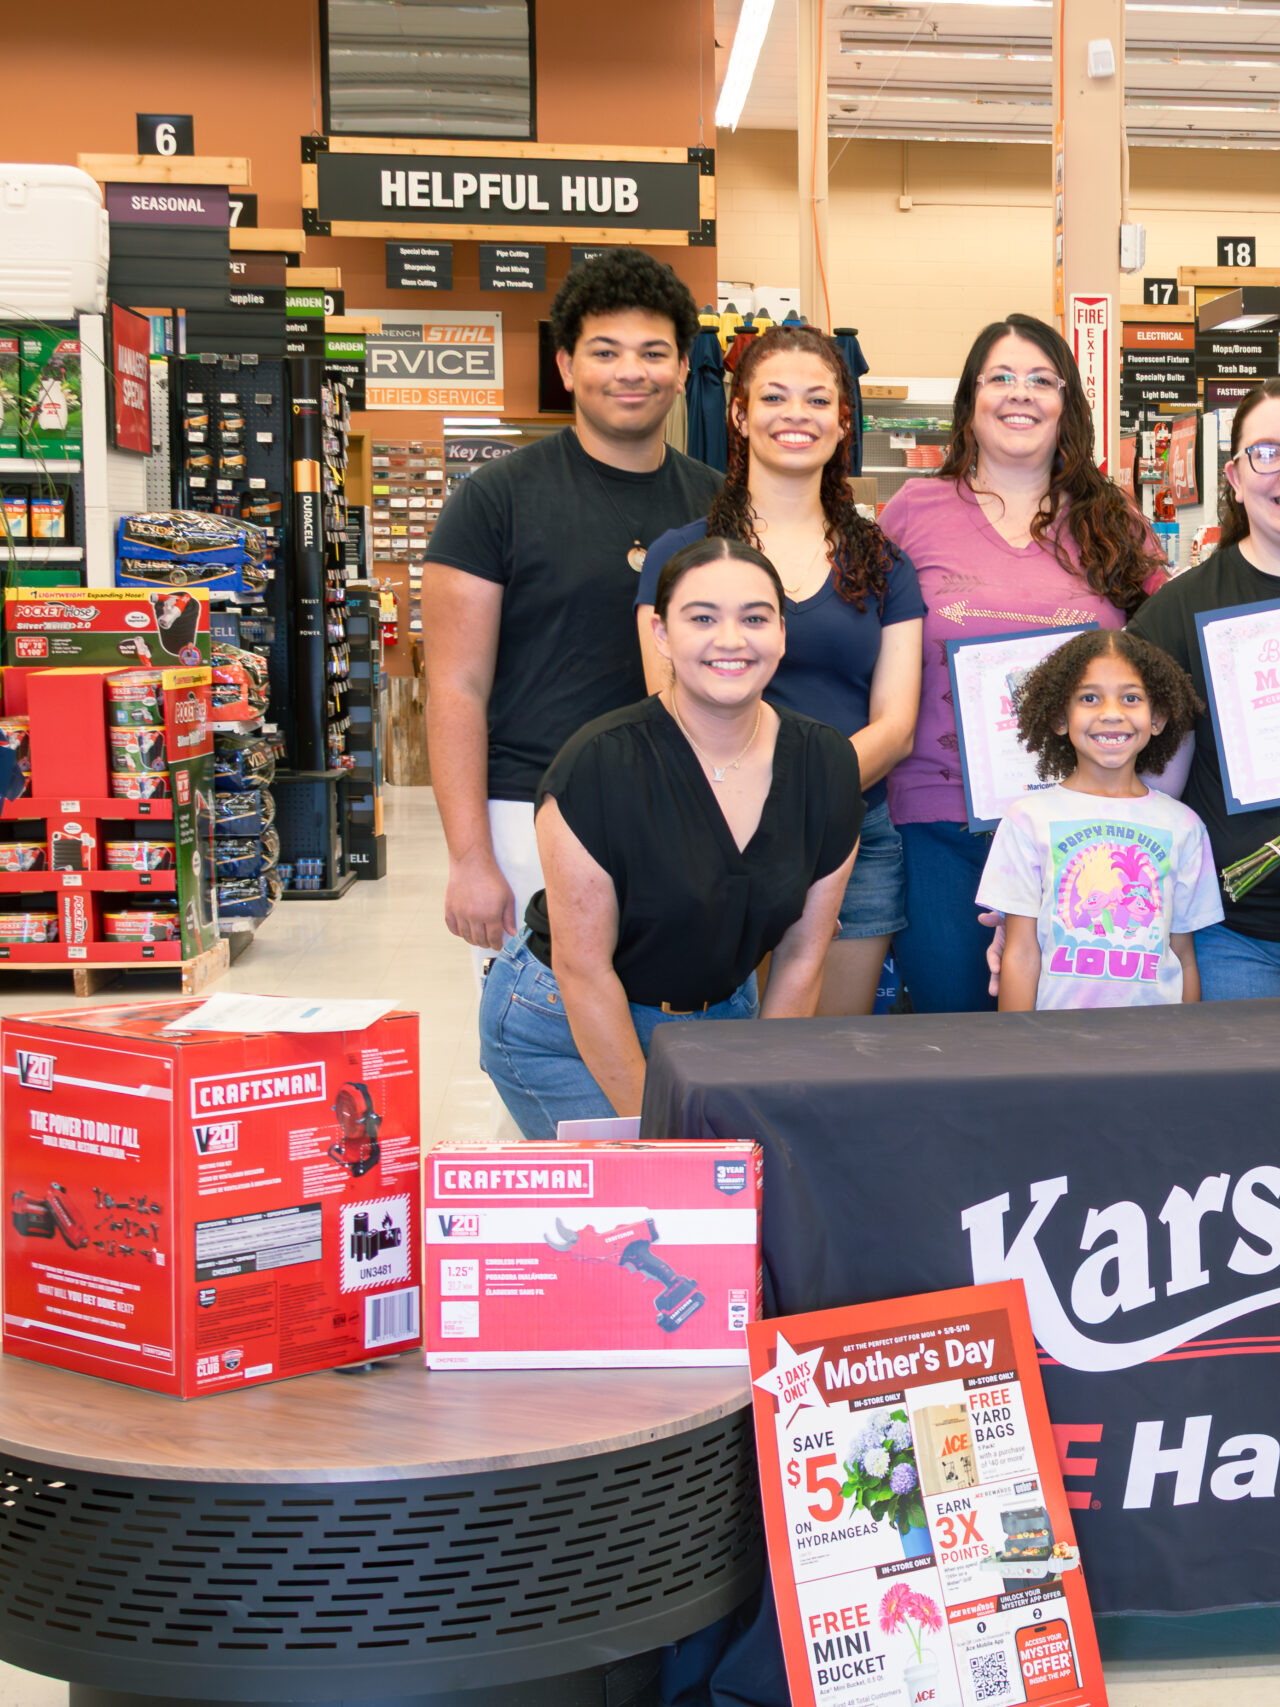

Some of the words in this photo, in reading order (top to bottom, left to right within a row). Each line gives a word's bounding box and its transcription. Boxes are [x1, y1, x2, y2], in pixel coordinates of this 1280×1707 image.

[155, 123, 177, 156] 6
[381, 170, 550, 211] HELPFUL
[561, 176, 639, 213] HUB
[131, 196, 205, 213] SEASONAL
[229, 202, 244, 228] 7
[400, 248, 420, 256] Special
[496, 250, 508, 258] Pipe
[1222, 243, 1251, 267] 18
[404, 263, 436, 272] Sharpening
[496, 265, 510, 273] Paint
[511, 266, 529, 274] Mixing
[417, 280, 437, 288] Cutting
[1149, 284, 1174, 305] 17
[324, 295, 334, 315] 9
[1077, 309, 1104, 324] FIRE
[427, 326, 492, 342] STIHL
[1137, 331, 1184, 341] ELECTRICAL
[328, 341, 364, 351] GARDEN
[1212, 344, 1262, 354] Mops/Brooms
[1128, 355, 1166, 364] Fluorescent
[1167, 356, 1189, 364] Fixture
[1136, 373, 1164, 382] Specialty
[1165, 374, 1185, 382] Bulbs
[1217, 365, 1237, 373] Trash
[1238, 365, 1257, 375] Bags
[428, 390, 496, 404] SERVICE
[1142, 391, 1159, 400] Light
[1160, 391, 1178, 399] Bulbs
[449, 445, 478, 462] Key
[303, 495, 314, 547] DURACELL
[15, 605, 65, 618] POCKET
[65, 606, 92, 618] Hose
[16, 622, 43, 630] Silver
[1058, 825, 1102, 853] POPPY
[1106, 825, 1134, 841] AND
[18, 1052, 51, 1083] V20
[199, 1073, 317, 1107] CRAFTSMAN
[30, 1110, 48, 1131] THE
[49, 1113, 82, 1138] POWER
[83, 1119, 95, 1141] TO
[96, 1121, 109, 1143] DO
[110, 1124, 121, 1144] IT
[121, 1126, 140, 1148] ALL
[194, 1123, 235, 1153] V20
[443, 1170, 583, 1190] CRAFTSMAN
[717, 1165, 726, 1178] 3
[726, 1166, 745, 1174] YEAR
[438, 1214, 478, 1237] V20
[360, 1264, 392, 1280] UN3481
[447, 1266, 468, 1277] 1.25
[67, 1290, 82, 1303] YOU
[868, 1337, 893, 1348] PERFECT
[894, 1335, 907, 1343] GIFT
[909, 1333, 920, 1341] FOR
[921, 1330, 936, 1340] MOM
[944, 1324, 970, 1335] 5/8-5/10
[197, 1364, 220, 1377] CLUB
[824, 1343, 940, 1391] Mother's
[945, 1338, 995, 1369] Day
[776, 1375, 783, 1390] 3
[785, 1361, 811, 1385] DAYS
[968, 1375, 998, 1386] IN-STORE
[999, 1372, 1014, 1381] ONLY
[854, 1396, 884, 1408] IN-STORE
[885, 1393, 901, 1402] ONLY
[969, 1388, 1011, 1410] FREE
[972, 1407, 1011, 1426] YARD
[975, 1423, 1015, 1442] BAGS
[793, 1431, 834, 1453] SAVE
[941, 1433, 968, 1457] ACE
[998, 1446, 1025, 1457] purchase
[984, 1486, 1011, 1497] REWARDS
[937, 1498, 971, 1515] EARN
[795, 1522, 812, 1535] ON
[797, 1522, 879, 1549] HYDRANGEAS
[936, 1510, 984, 1549] 3X
[941, 1543, 989, 1564] POINTS
[881, 1560, 914, 1574] IN-STORE
[914, 1557, 931, 1567] ONLY
[1000, 1591, 1023, 1603] UNLOCK
[1024, 1588, 1041, 1597] YOUR
[1002, 1597, 1029, 1610] MYSTERY
[1030, 1595, 1041, 1603] APP
[1043, 1591, 1061, 1600] OFFER
[949, 1609, 961, 1619] ACE
[962, 1602, 995, 1615] REWARDS
[808, 1603, 871, 1638] FREE
[813, 1631, 871, 1664] MINI
[977, 1641, 993, 1649] Mobile
[994, 1639, 1004, 1647] App
[1025, 1637, 1046, 1647] ACCESS
[1047, 1633, 1062, 1642] YOUR
[1020, 1639, 1069, 1661] MYSTERY
[817, 1655, 886, 1686] BUCKET
[1029, 1676, 1048, 1685] INSIDE
[1059, 1669, 1071, 1677] APP
[871, 1689, 902, 1700] Customers
[914, 1689, 935, 1703] ACE
